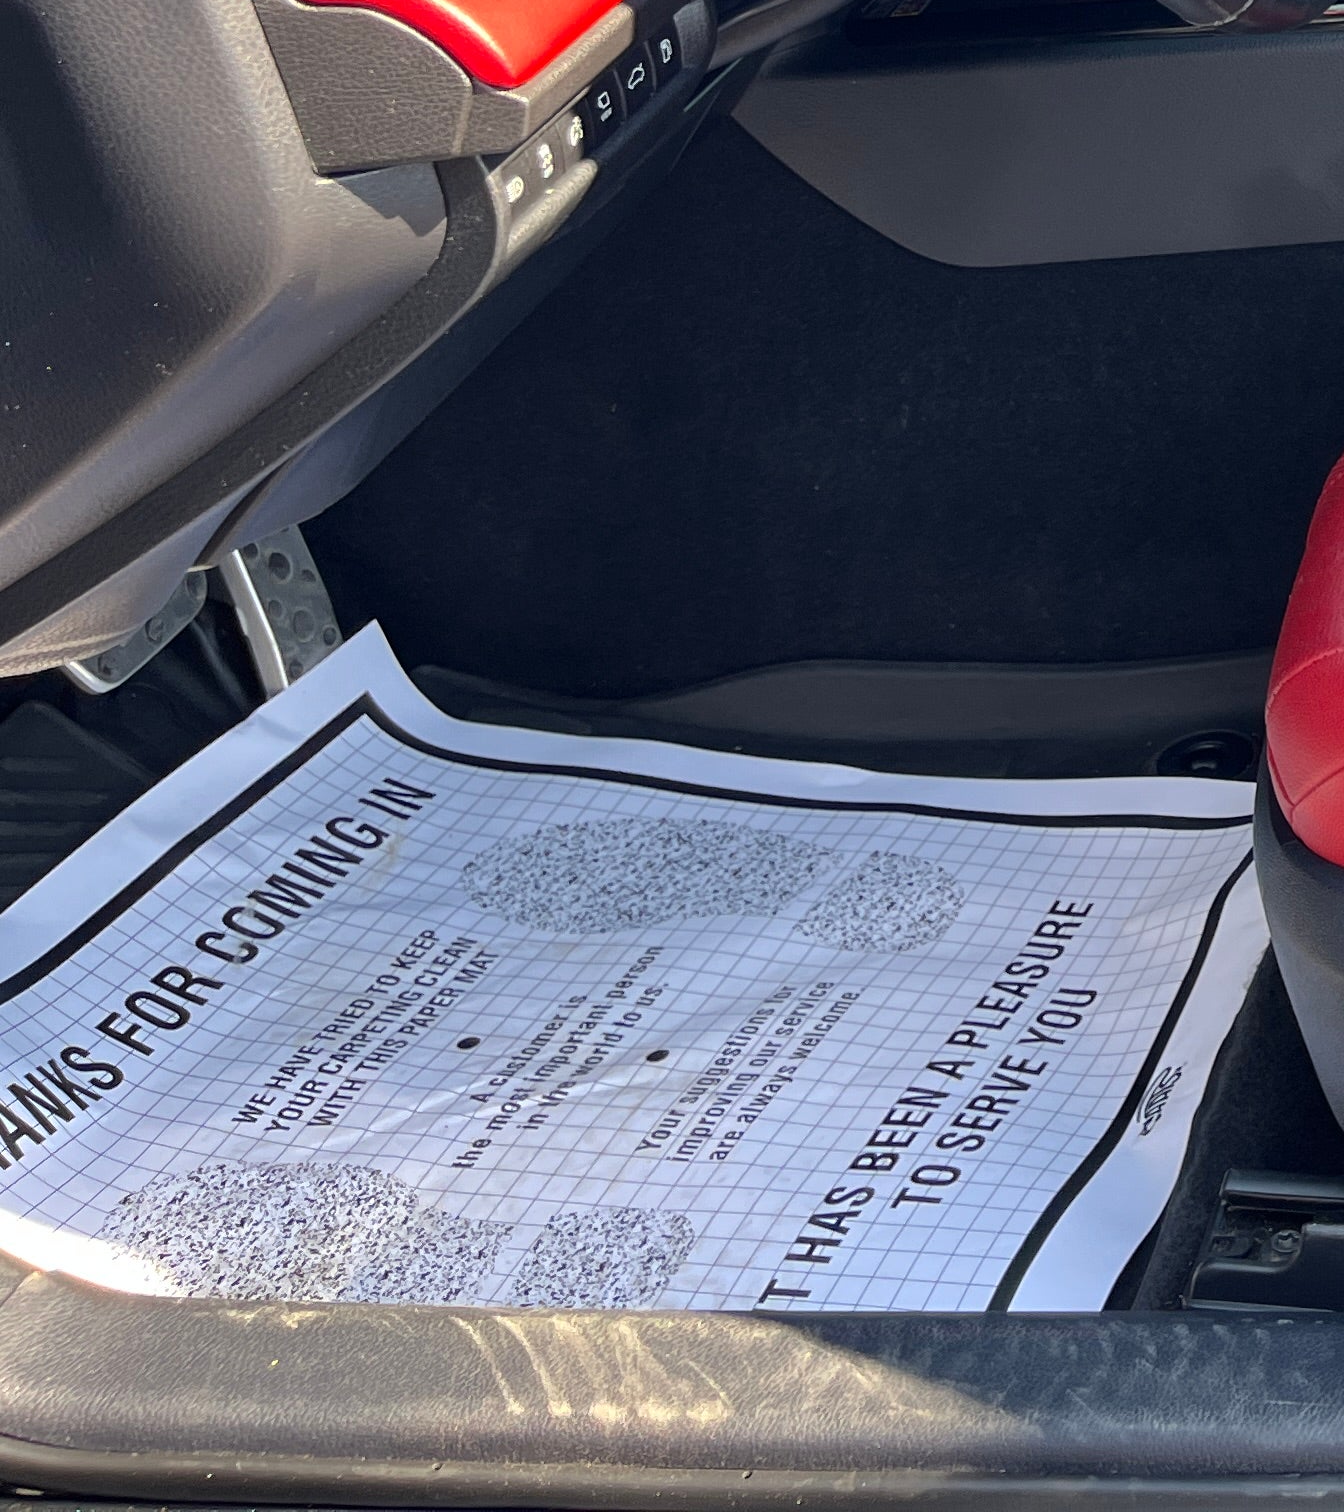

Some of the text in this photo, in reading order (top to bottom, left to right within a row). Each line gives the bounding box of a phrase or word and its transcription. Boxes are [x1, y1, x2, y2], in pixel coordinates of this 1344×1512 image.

[0, 777, 436, 1170] ANKS FOR COMING IN
[232, 929, 440, 1125] WE HAVE TRIED TO KEEP
[264, 936, 478, 1133] YOUR CARPETING CLEAN
[306, 950, 499, 1127] WITH THIS PAPER MAT
[470, 995, 587, 1103] A customer is
[946, 899, 1094, 1050] PLEASURE
[452, 946, 664, 1168] the most important person
[516, 983, 669, 1130] in the world to us.
[634, 986, 797, 1151] Your suggestions for
[666, 981, 834, 1162] improving our service
[709, 1131, 744, 1160] are
[737, 1064, 797, 1124] always
[848, 1087, 950, 1173] BEEN
[891, 988, 1097, 1208] TO SERVE YOU
[926, 1057, 976, 1081] A
[784, 1186, 875, 1264] HAS
